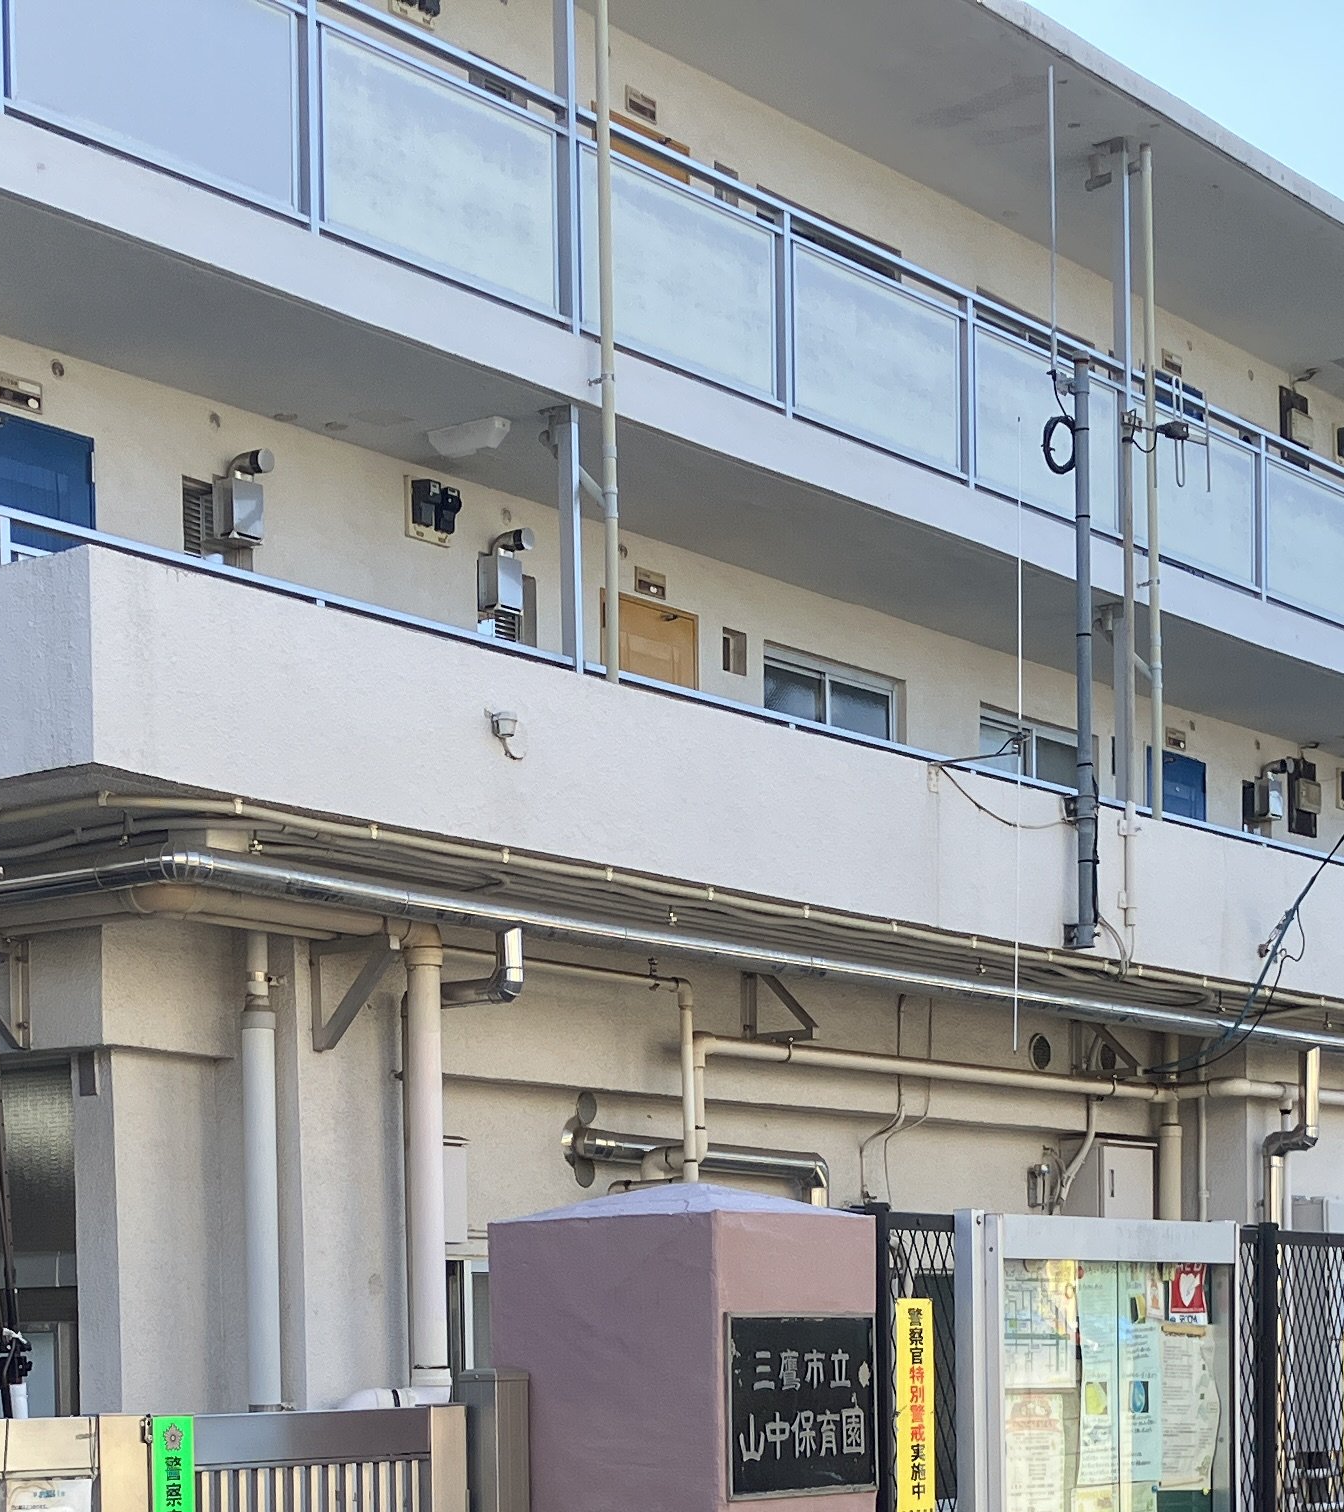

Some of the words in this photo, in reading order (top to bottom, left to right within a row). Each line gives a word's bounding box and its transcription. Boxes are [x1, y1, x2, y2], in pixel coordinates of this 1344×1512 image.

[753, 1348, 851, 1391] 三鷹市立
[907, 1308, 926, 1500] 警察官特別警戒実施中
[739, 1407, 865, 1462] 山中保育園
